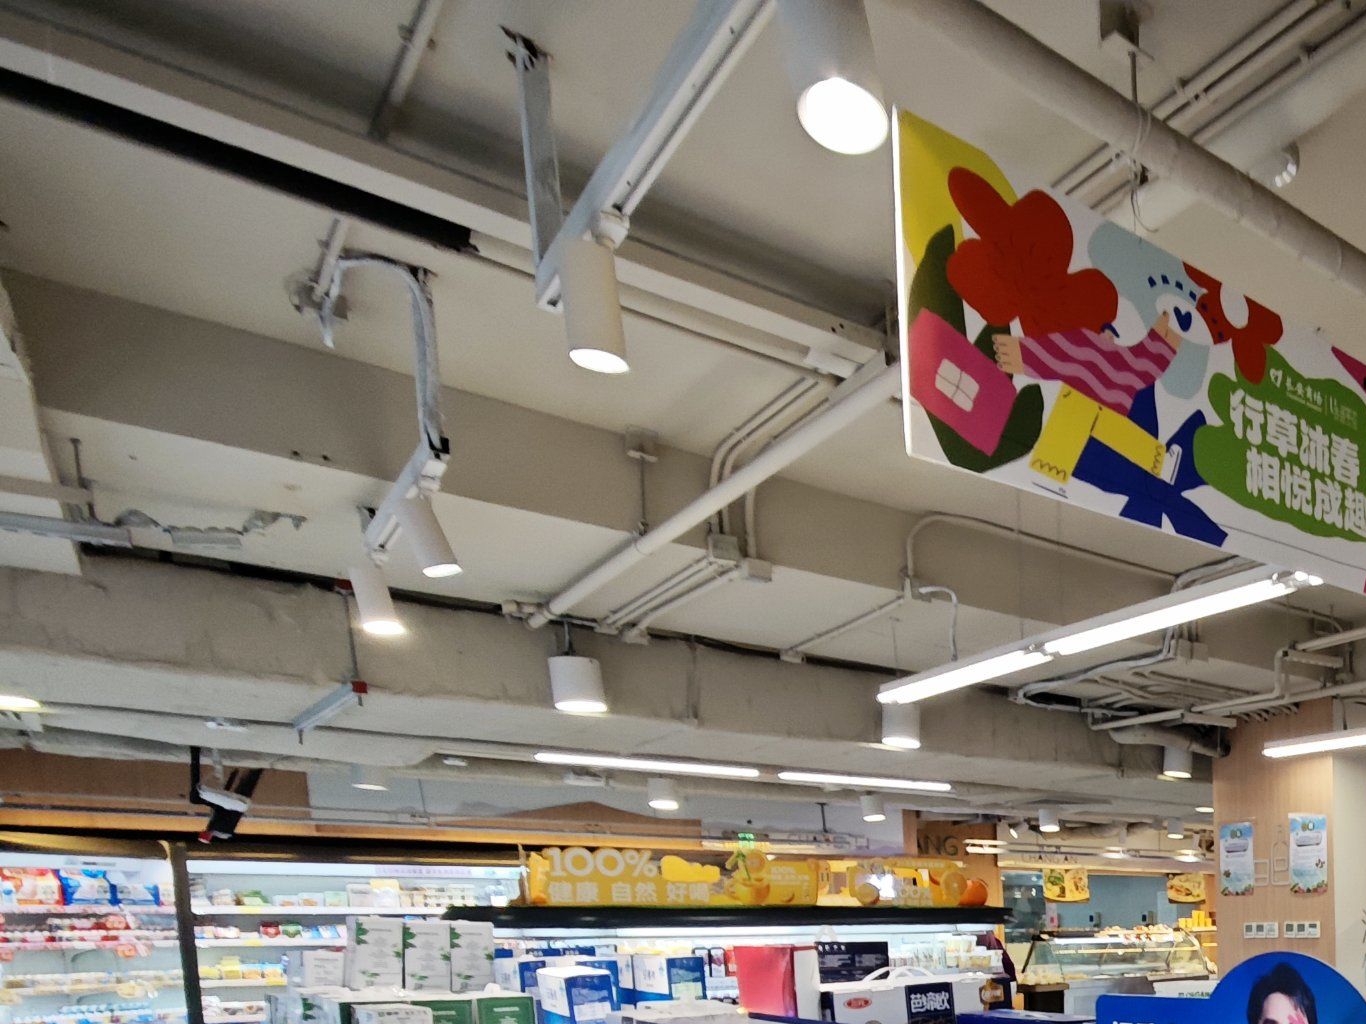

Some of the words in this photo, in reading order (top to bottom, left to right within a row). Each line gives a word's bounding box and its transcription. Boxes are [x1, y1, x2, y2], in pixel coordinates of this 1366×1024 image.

[1229, 388, 1360, 488] 行草沐春
[545, 847, 659, 877] 100%
[548, 880, 599, 902] 健康
[611, 881, 658, 902] 自然
[666, 882, 709, 902] 好喝
